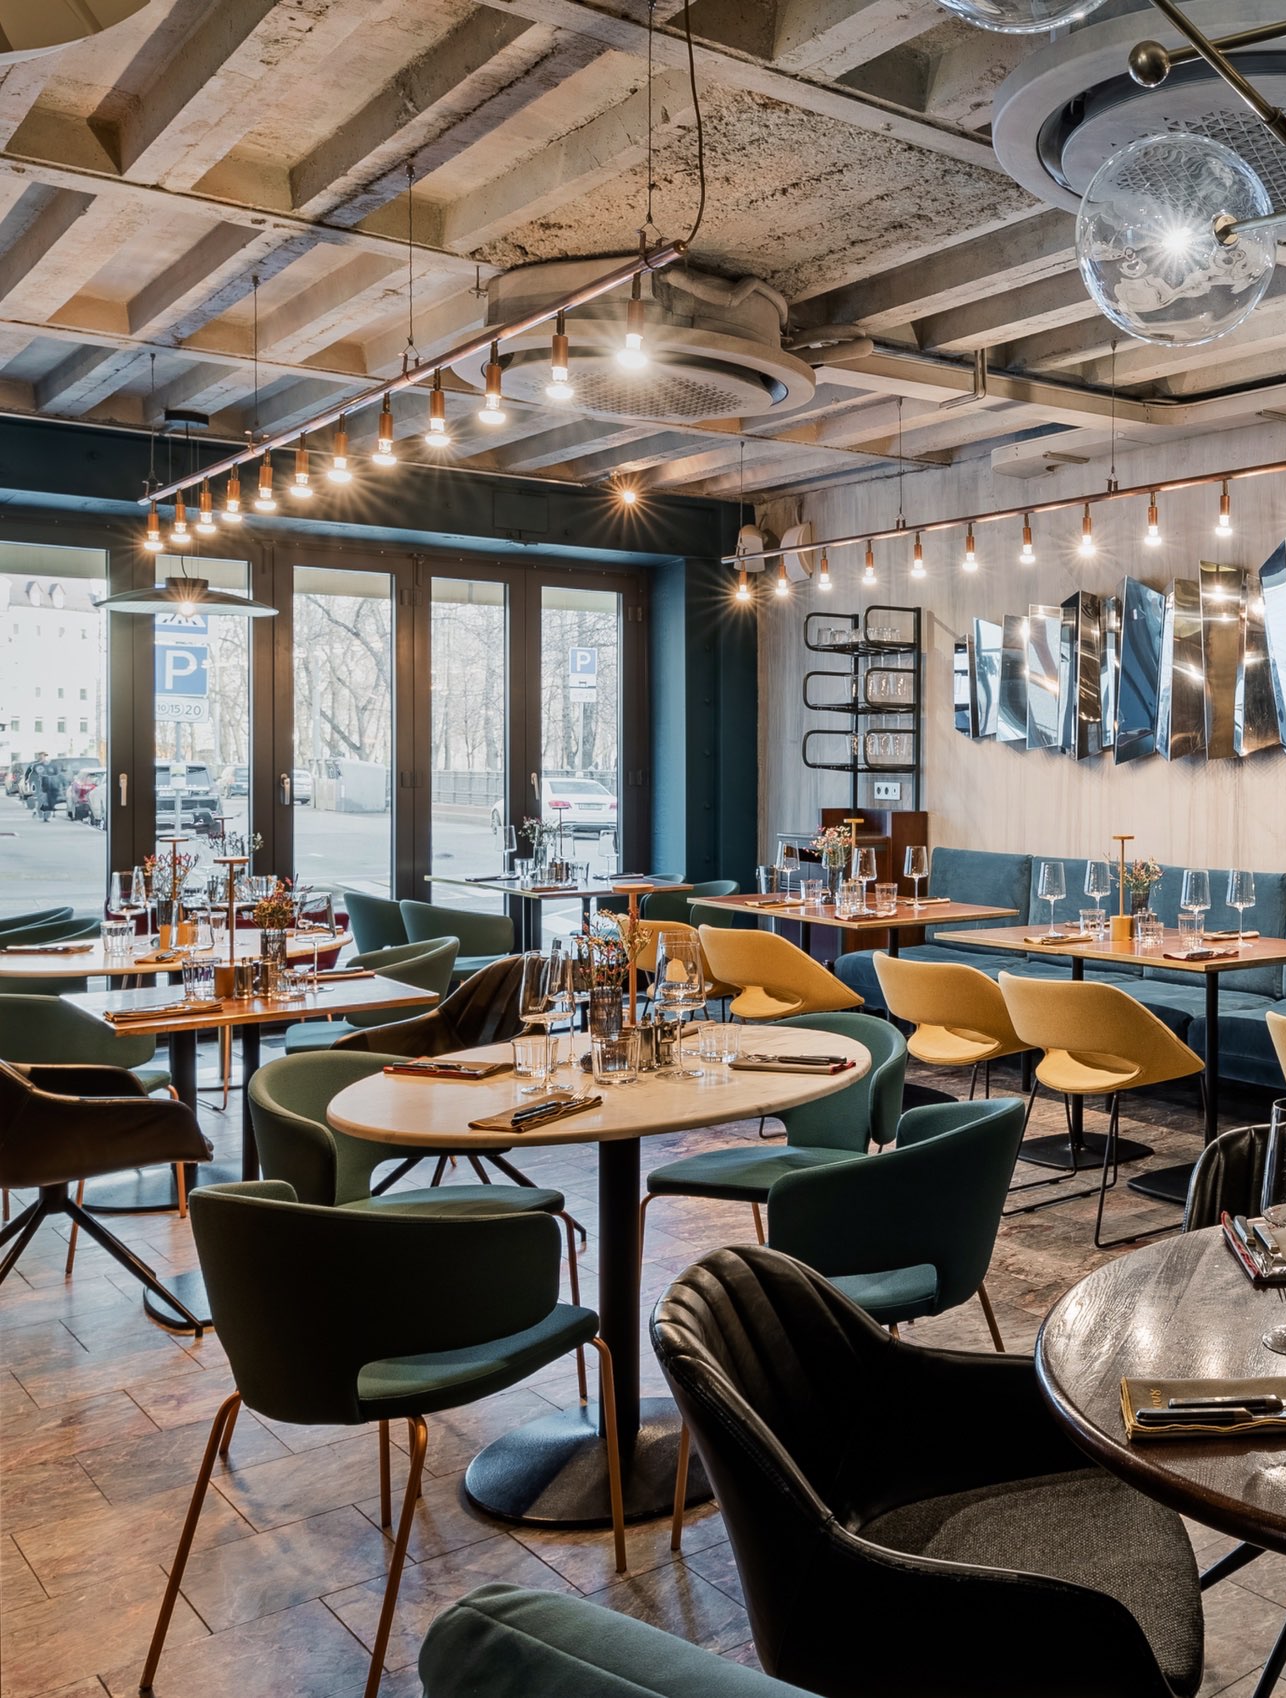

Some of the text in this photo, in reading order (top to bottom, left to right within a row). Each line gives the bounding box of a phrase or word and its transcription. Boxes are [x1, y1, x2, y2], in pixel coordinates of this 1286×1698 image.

[165, 649, 198, 690] P
[576, 650, 592, 672] P
[170, 704, 181, 714] 15
[185, 704, 202, 716] 20
